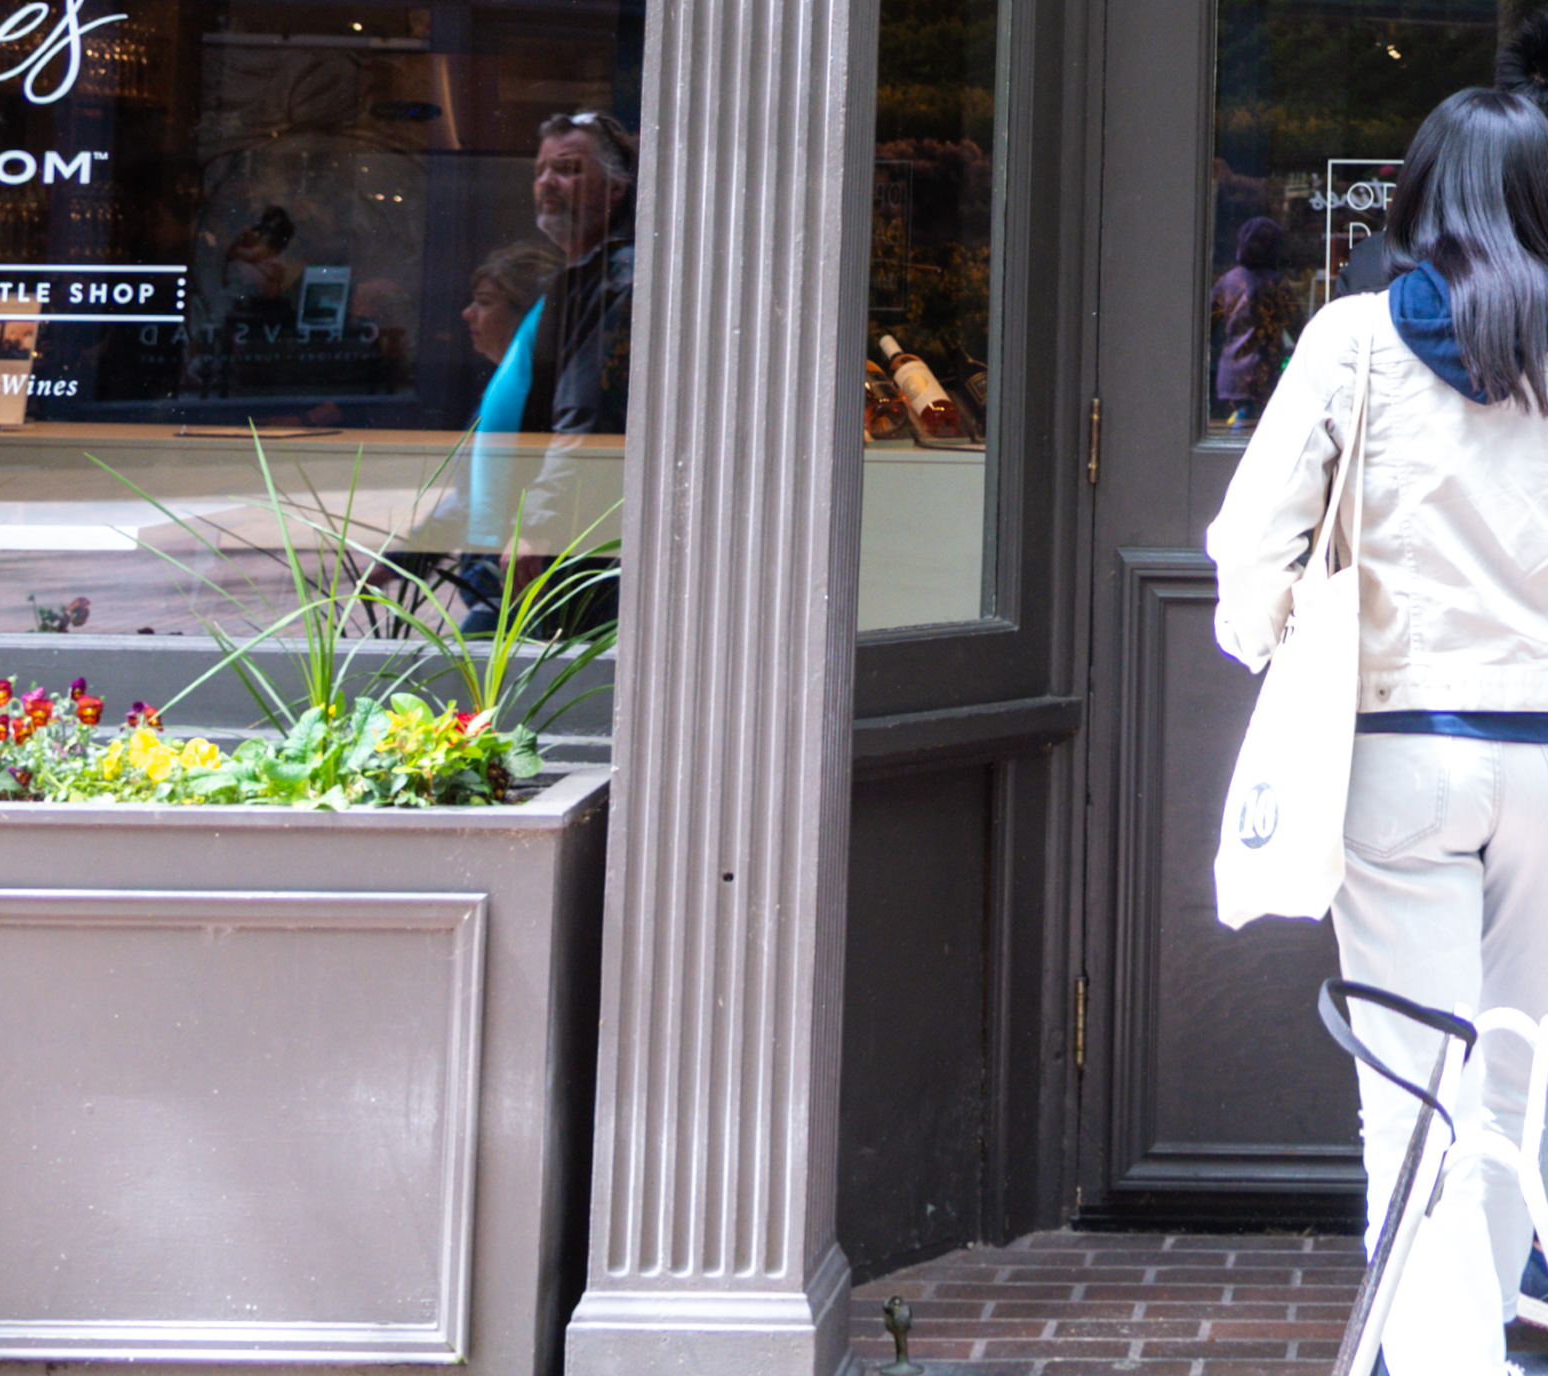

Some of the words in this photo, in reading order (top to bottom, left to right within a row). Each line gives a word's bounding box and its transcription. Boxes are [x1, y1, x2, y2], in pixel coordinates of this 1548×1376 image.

[69, 283, 156, 305] SHOP
[0, 372, 79, 398] Wines
[1239, 785, 1276, 841] 10
